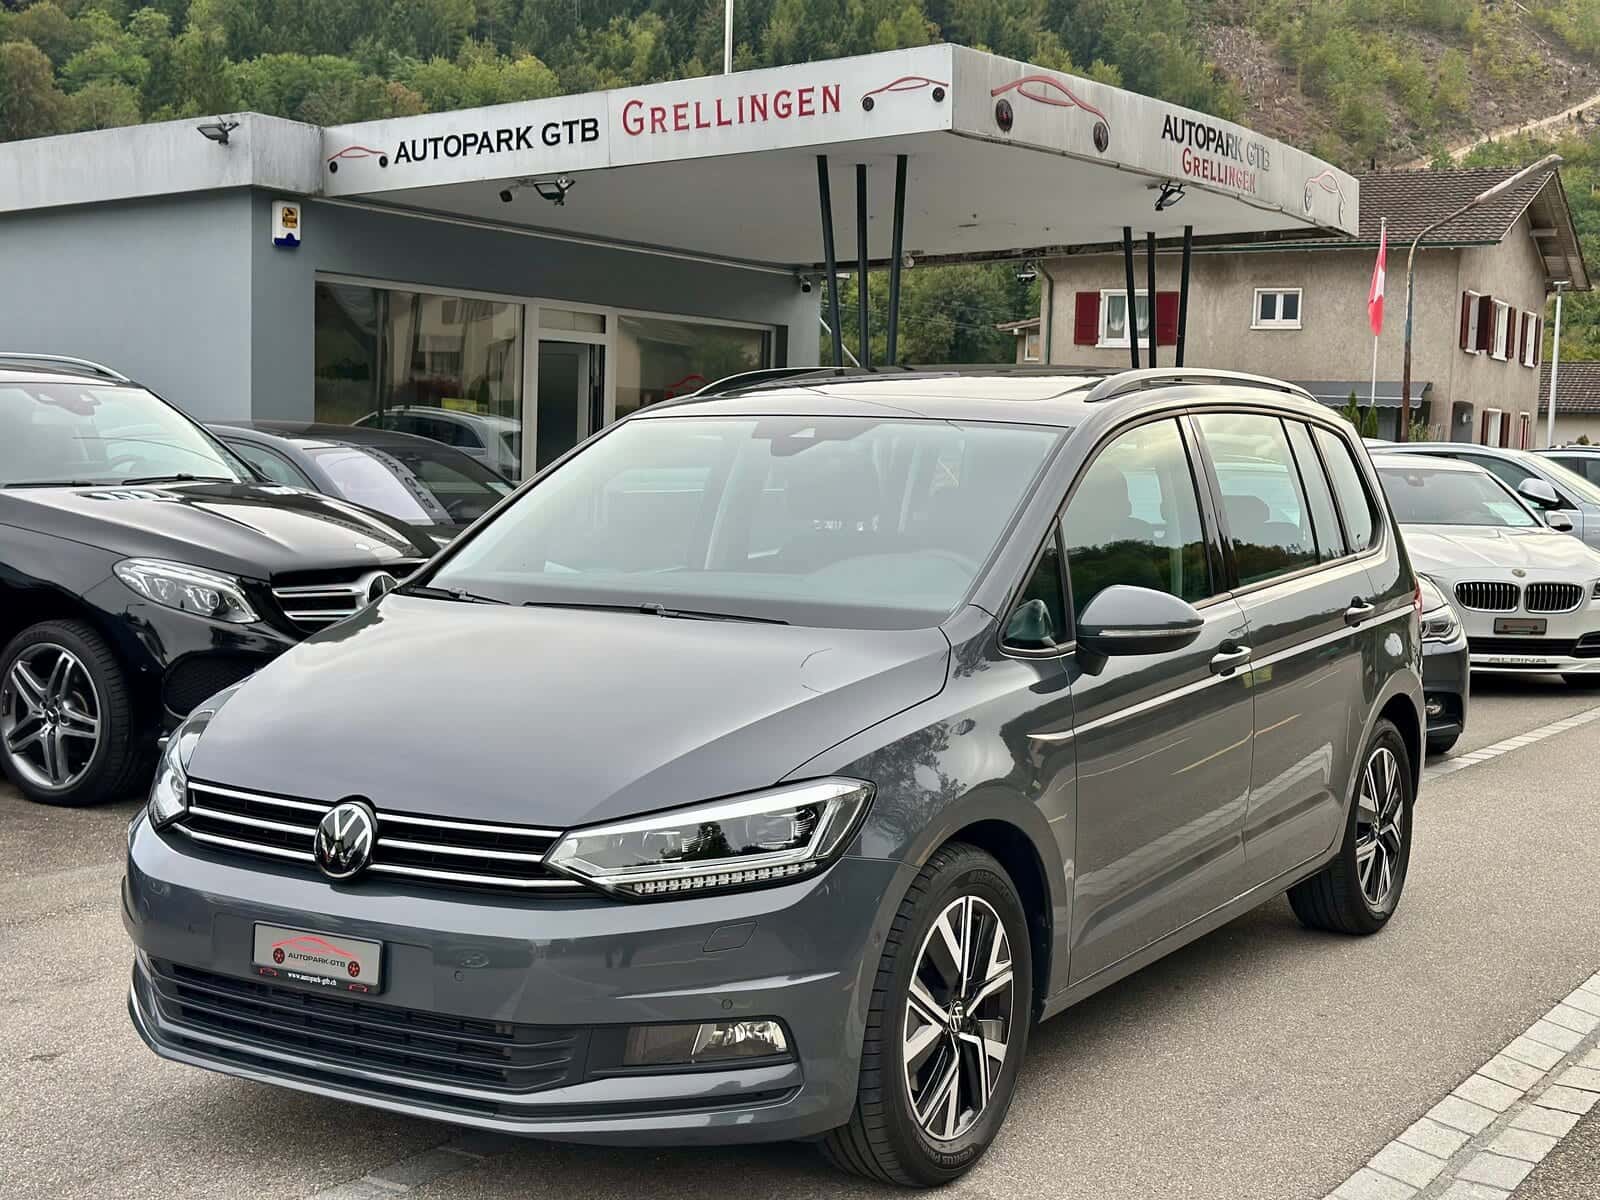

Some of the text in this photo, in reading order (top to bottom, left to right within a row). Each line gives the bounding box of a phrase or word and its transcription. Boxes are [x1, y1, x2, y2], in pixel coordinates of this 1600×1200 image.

[622, 84, 841, 136] GRELLINGEN
[394, 117, 600, 165] AUTOPARK GTB
[1161, 113, 1271, 172] AUTOPARK GTB
[1181, 147, 1257, 194] GRELLINGEN
[287, 951, 346, 968] AUTOPARK-GTB
